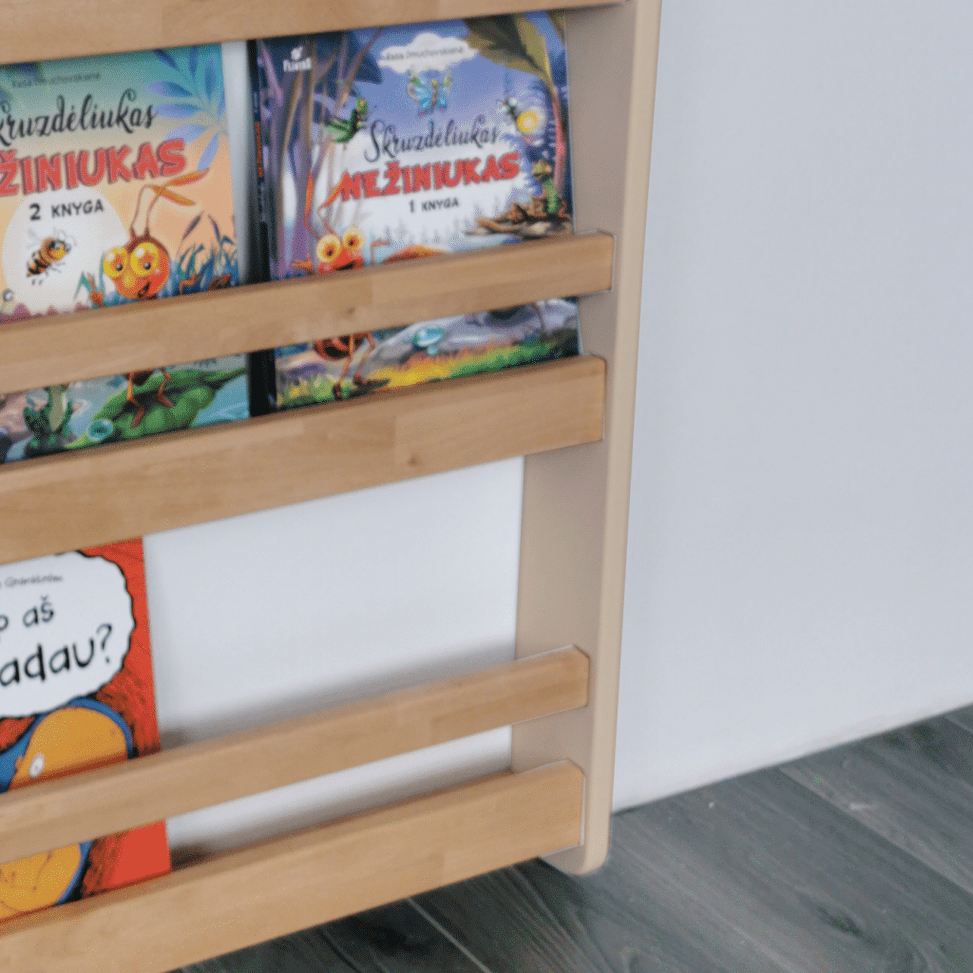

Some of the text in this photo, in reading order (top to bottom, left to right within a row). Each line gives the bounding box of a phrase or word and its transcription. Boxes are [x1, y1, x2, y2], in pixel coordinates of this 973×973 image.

[364, 114, 499, 163] Skruzdėliukas
[340, 152, 521, 202] NEŽINIUKAS
[29, 199, 105, 220] 2 KNYGA
[409, 198, 459, 213] 1 KNYGA
[23, 595, 54, 628] aš
